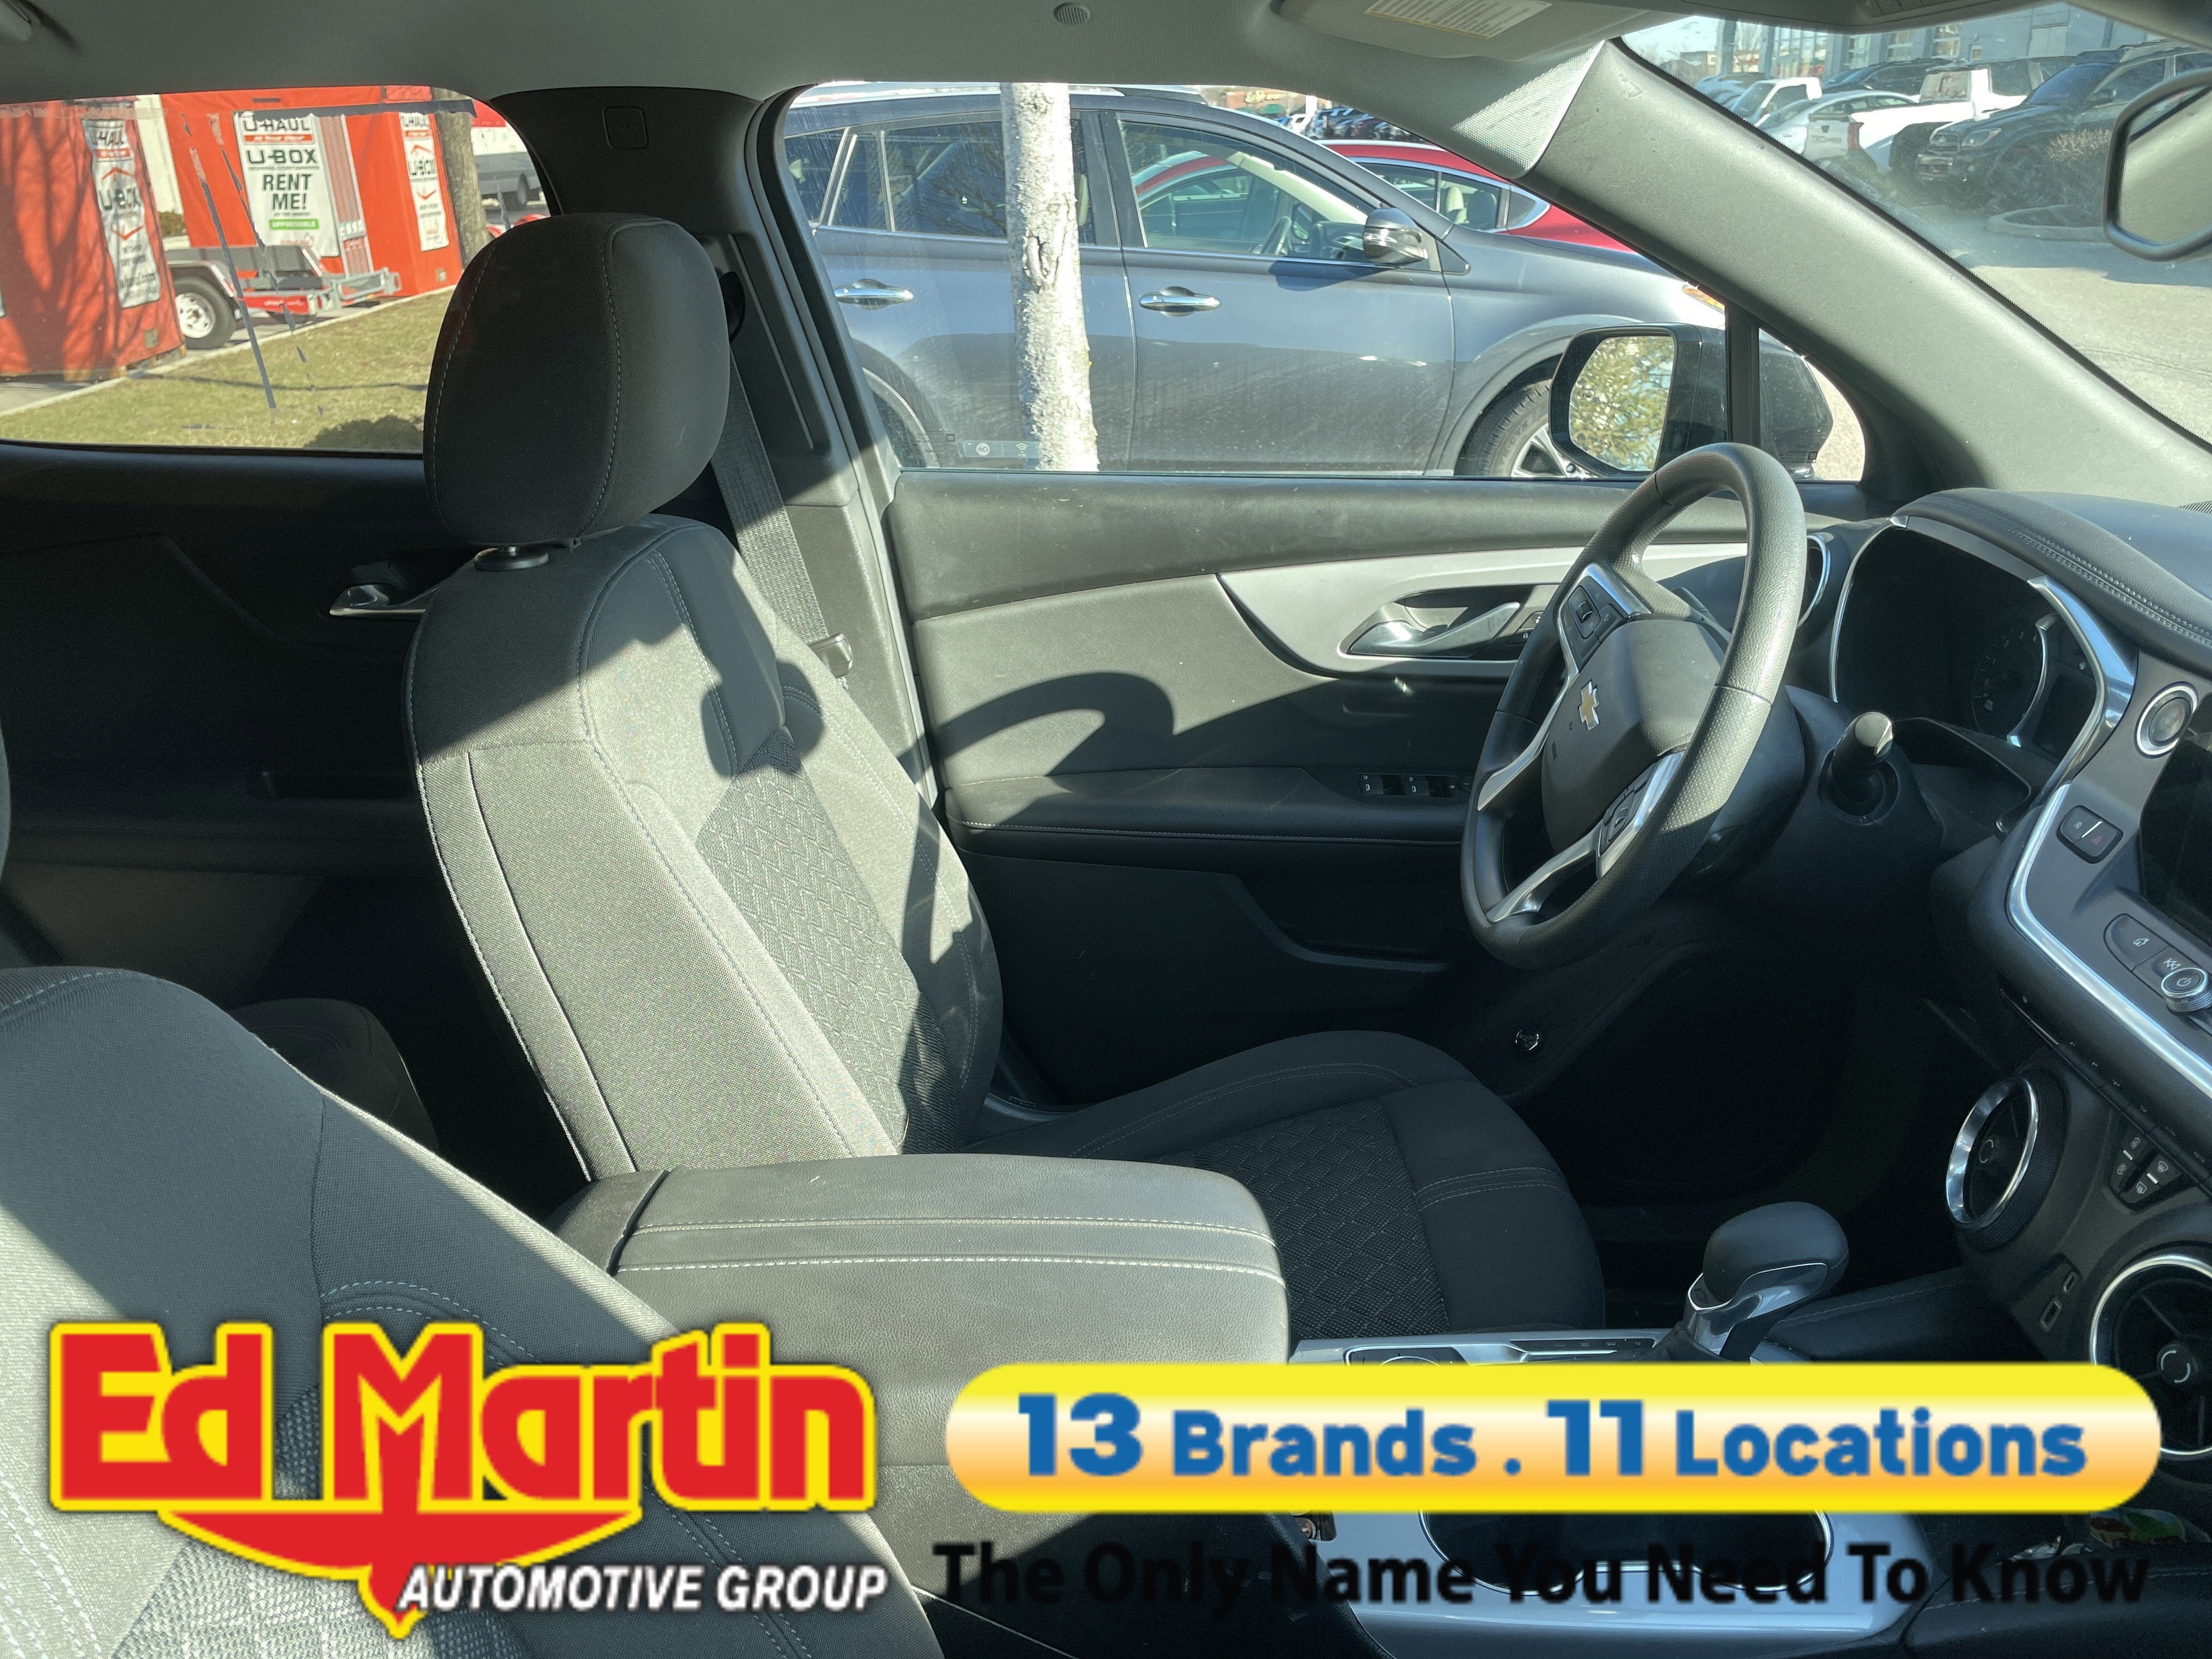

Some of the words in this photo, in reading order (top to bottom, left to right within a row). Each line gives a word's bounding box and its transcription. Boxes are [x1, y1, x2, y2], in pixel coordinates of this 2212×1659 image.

[244, 119, 310, 131] U-HAUL
[247, 149, 317, 164] U-BOX
[262, 174, 312, 190] RENT
[272, 193, 307, 210] ME!
